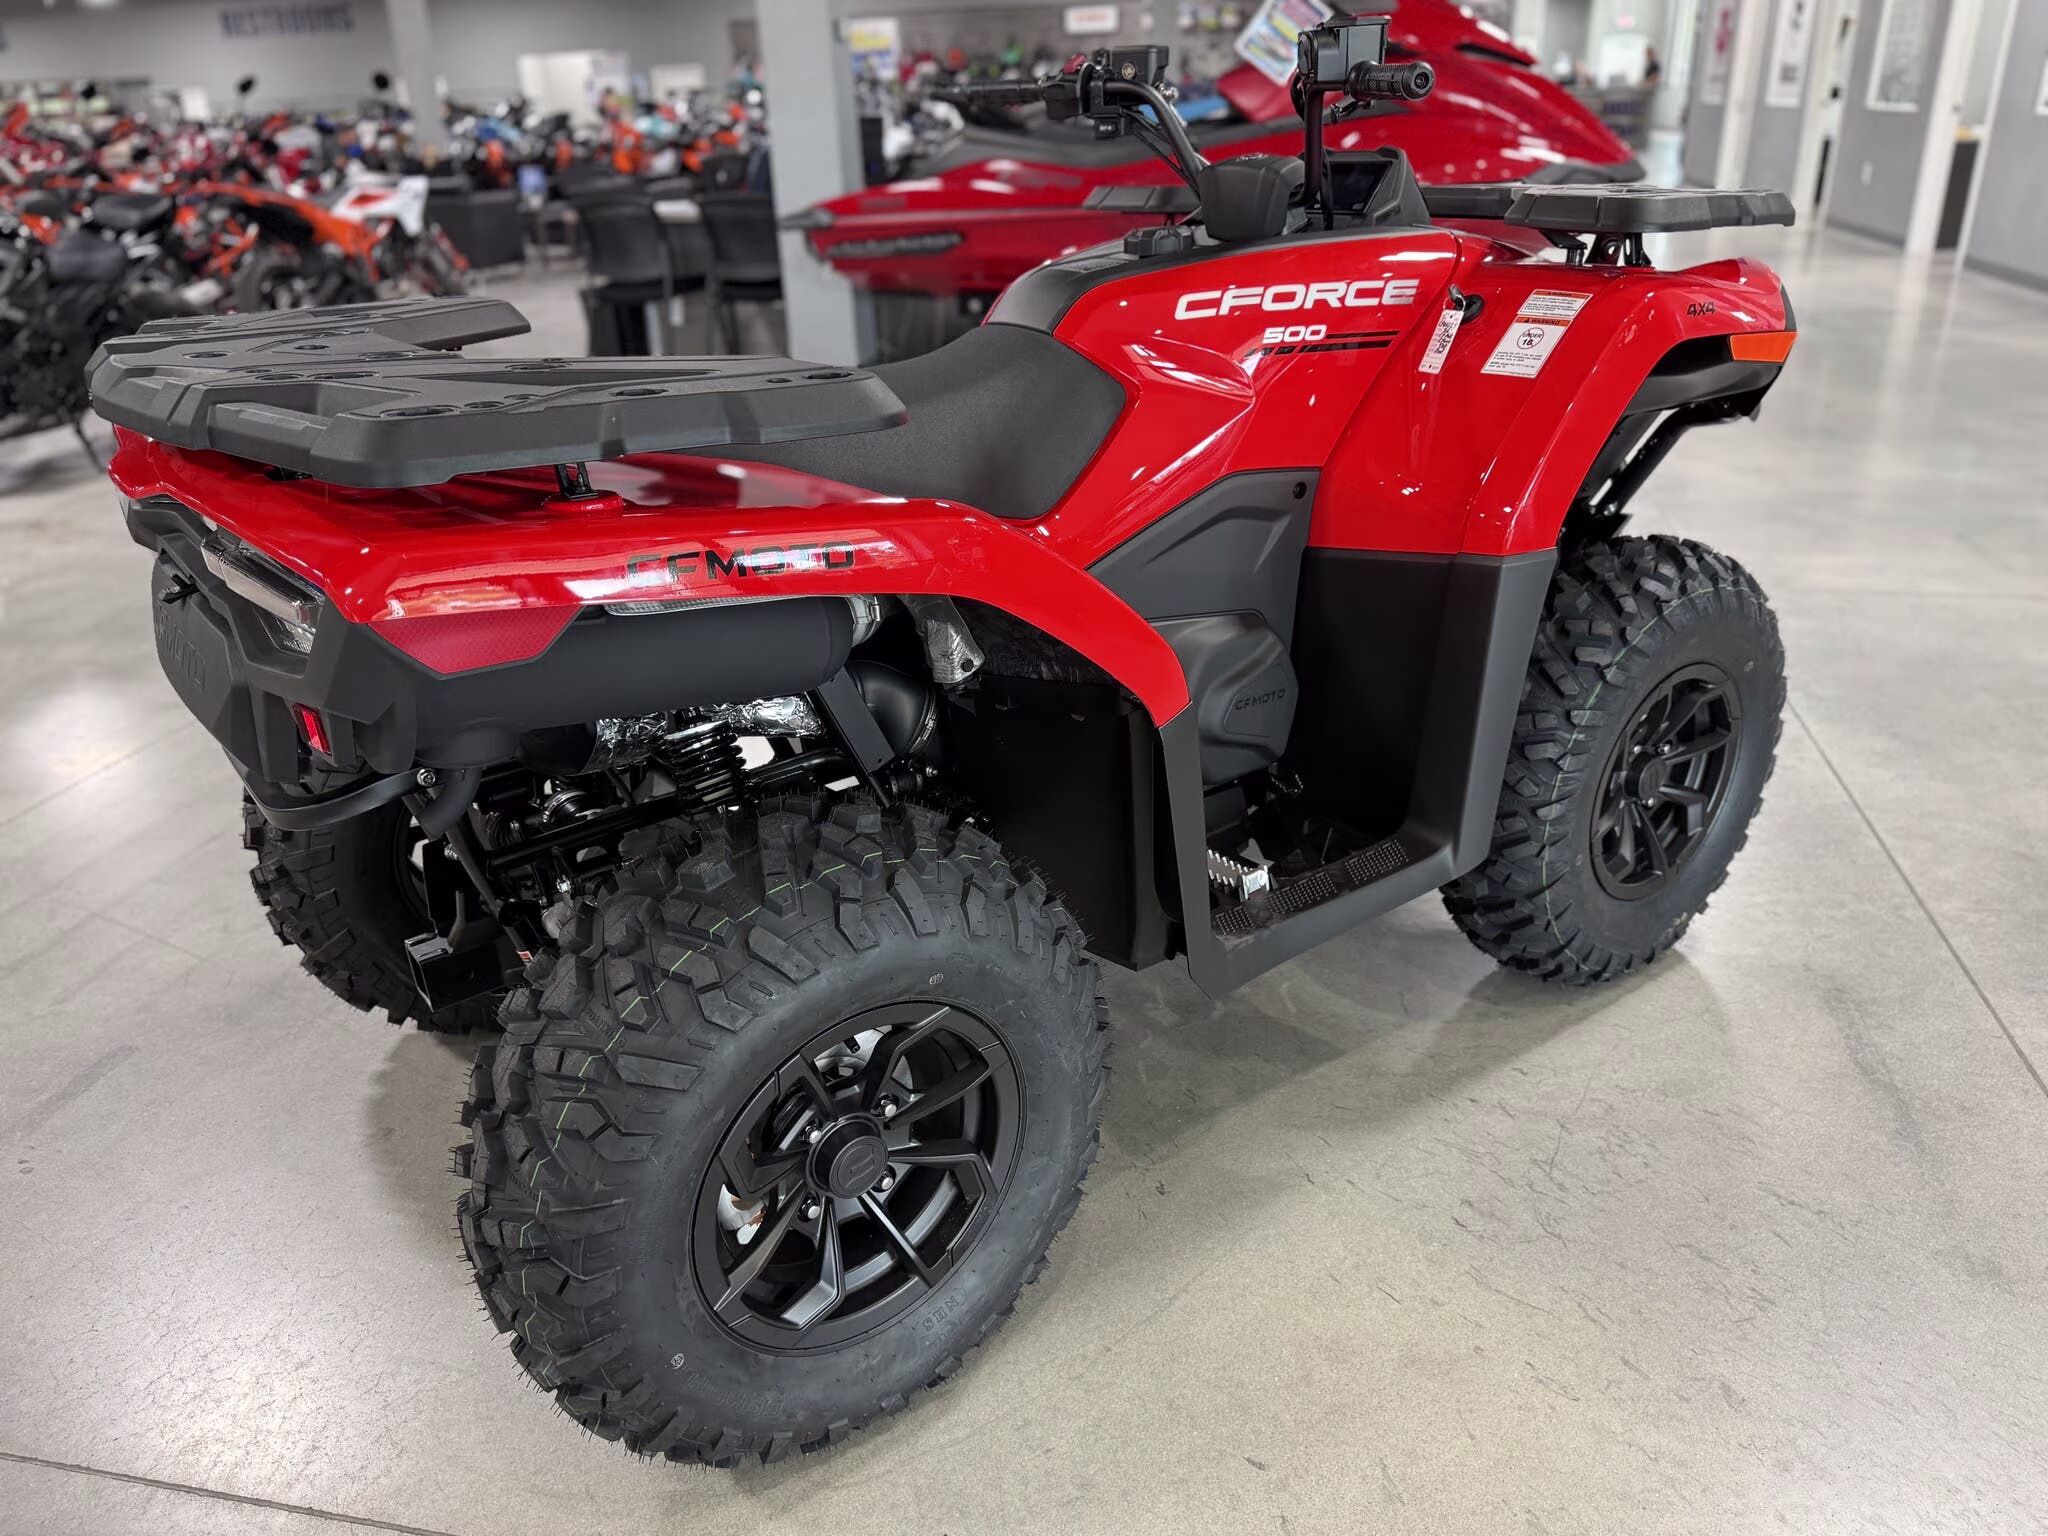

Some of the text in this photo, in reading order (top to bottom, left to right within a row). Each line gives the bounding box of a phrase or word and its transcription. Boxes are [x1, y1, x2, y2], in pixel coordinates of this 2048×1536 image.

[1174, 279, 1420, 320] CFORCE
[1687, 302, 1716, 316] 4X4
[1261, 324, 1328, 344] 500
[1521, 338, 1534, 346] 16
[626, 540, 855, 586] CFMOTO
[1235, 688, 1286, 710] CFMOTO
